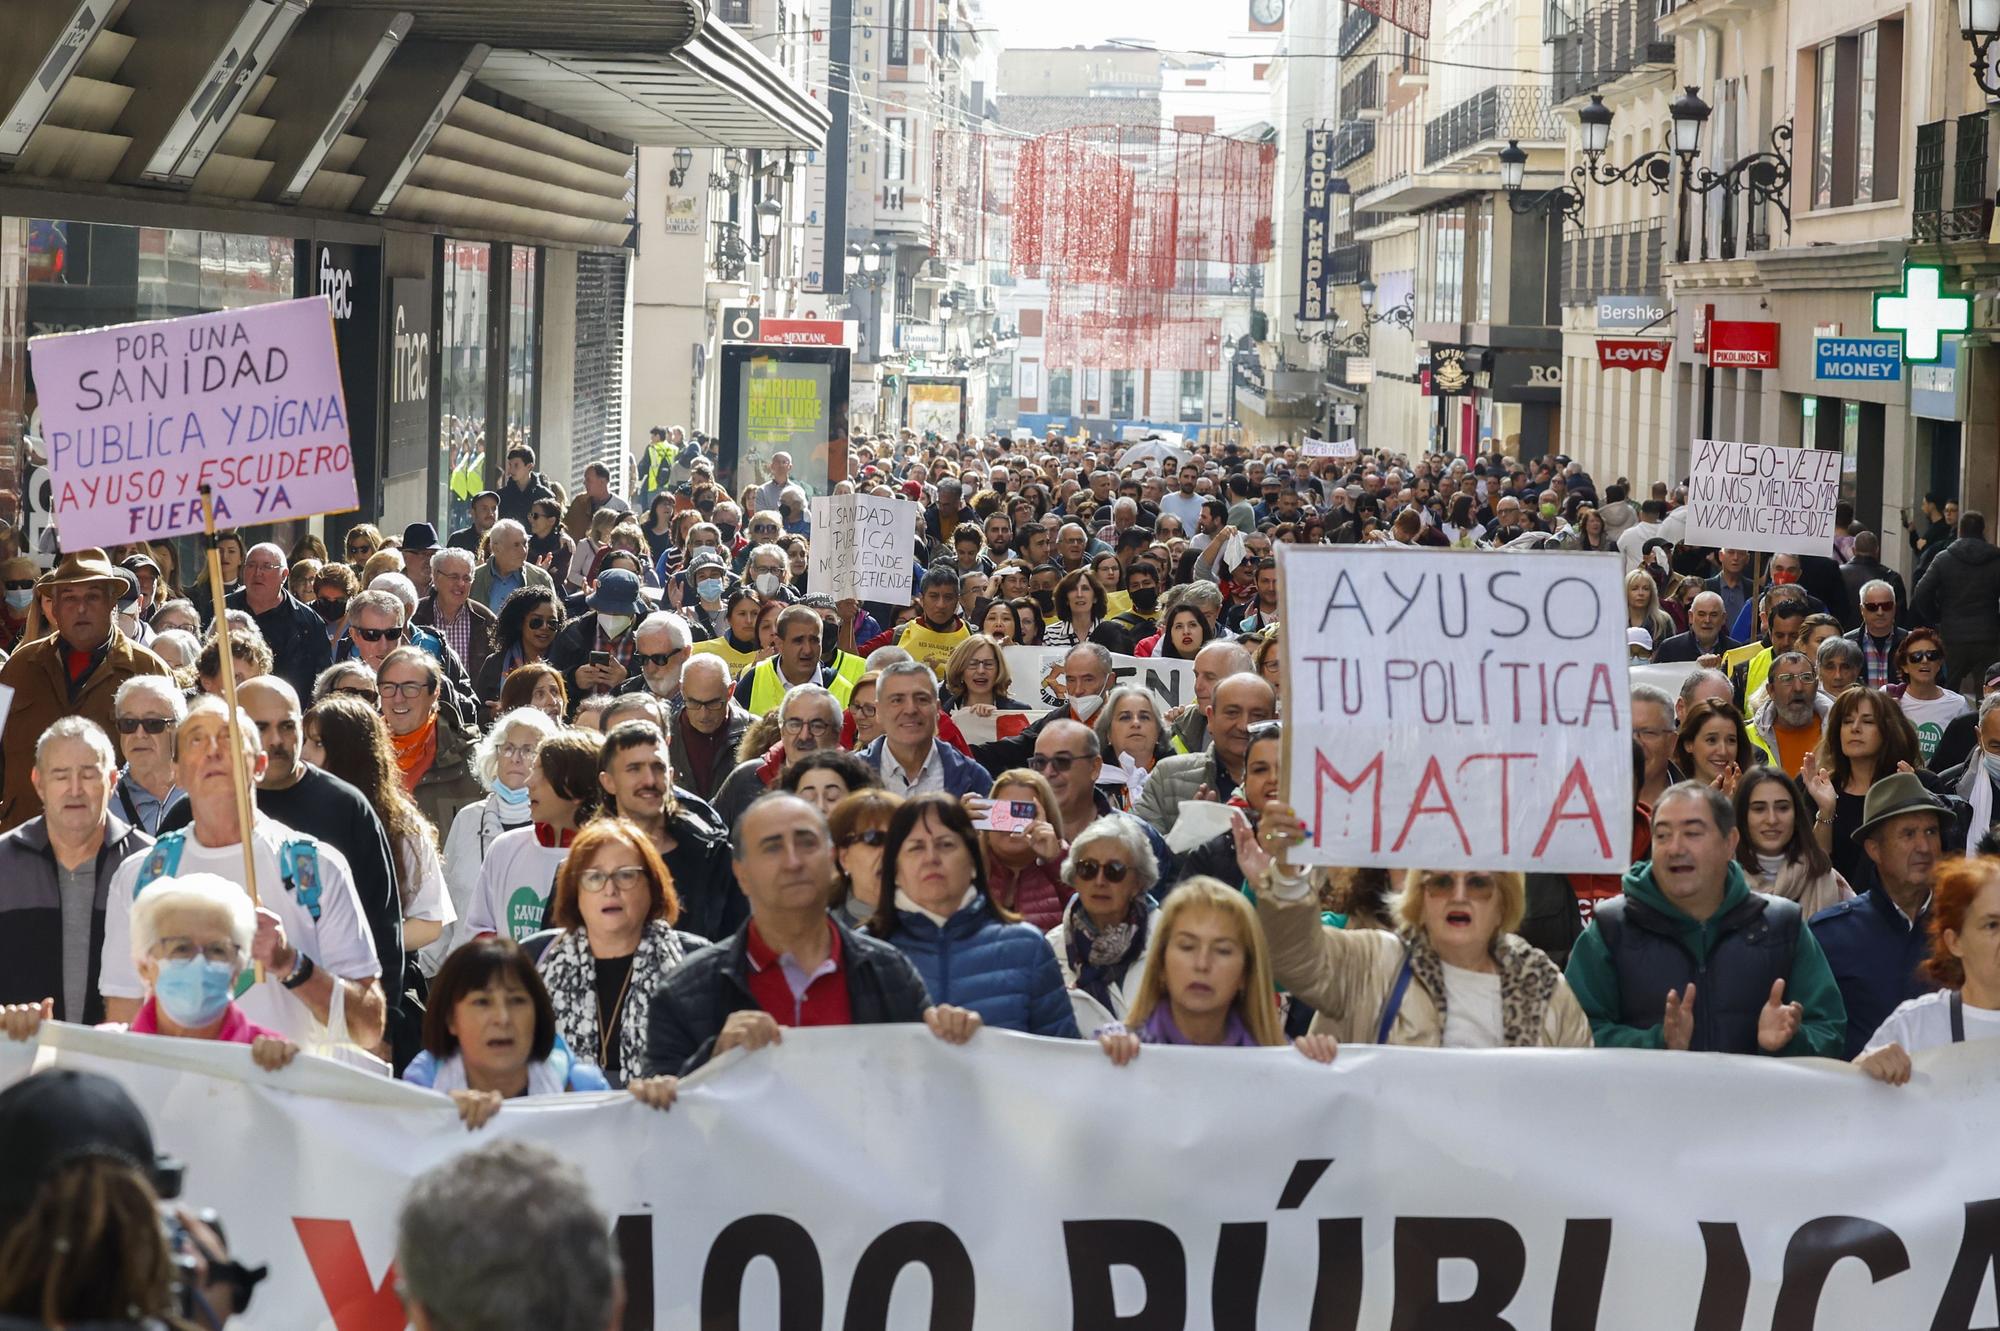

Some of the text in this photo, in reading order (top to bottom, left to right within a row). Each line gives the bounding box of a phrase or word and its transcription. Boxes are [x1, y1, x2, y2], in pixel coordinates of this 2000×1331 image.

[812, 29, 822, 42] 10
[320, 247, 352, 319] fnac
[1305, 218, 1324, 319] SPORT
[1601, 305, 1664, 319] Bershka
[116, 322, 250, 363] POR UNA
[394, 304, 428, 402] fnac
[1716, 351, 1756, 362] PIKOLINOS
[1820, 343, 1899, 358] CHANGE
[748, 378, 817, 399] MARIANO
[1824, 363, 1893, 377] MONEY
[221, 404, 242, 446] Y
[58, 469, 165, 513] AYUSO
[196, 444, 350, 492] ESCUDERO
[1692, 476, 1715, 501] NO
[1720, 476, 1752, 504] NOS
[128, 484, 292, 534] FUERA YA
[850, 570, 912, 589] DEFIENDE
[851, 551, 903, 570] VENDE
[1318, 568, 1601, 640] AYUSO
[1301, 649, 1620, 732] TU POLÍTICA
[1313, 746, 1613, 860] MATA
